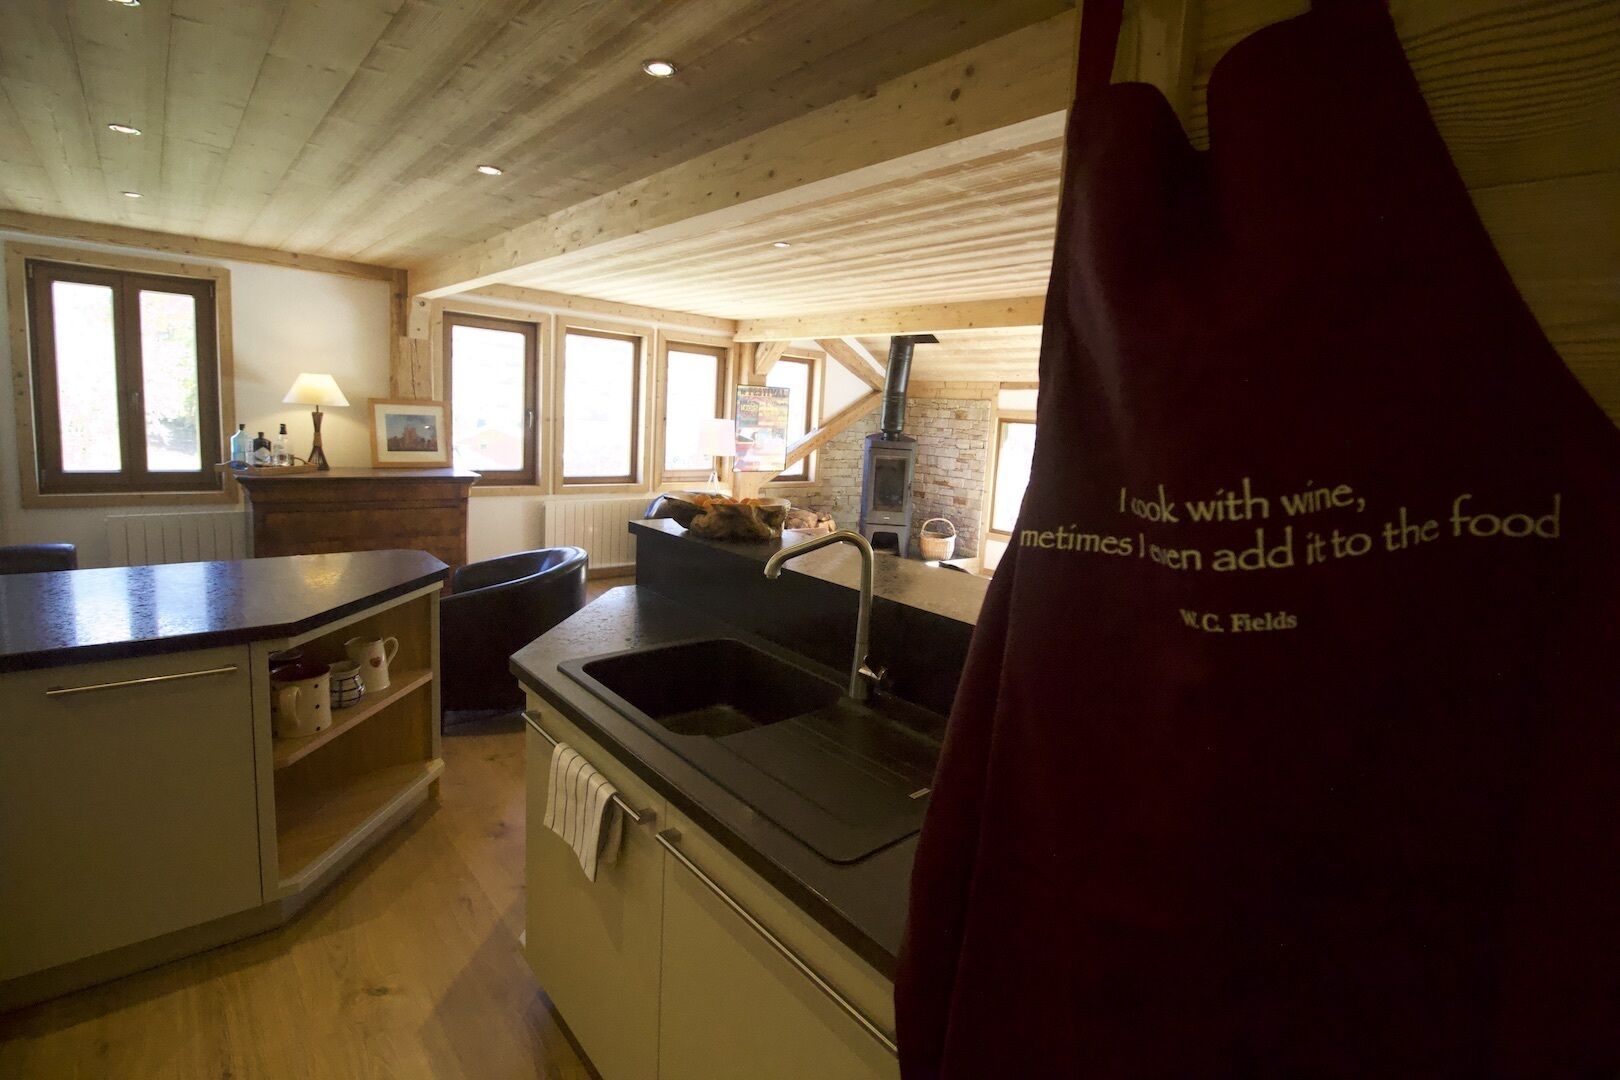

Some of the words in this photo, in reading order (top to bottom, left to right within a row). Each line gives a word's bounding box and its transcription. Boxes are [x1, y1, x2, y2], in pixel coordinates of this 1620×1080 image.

[1119, 487, 1126, 513] I
[1131, 484, 1180, 523] cook
[1185, 477, 1270, 523] with
[1280, 480, 1366, 517] wine,
[1019, 524, 1134, 557] metimes
[1139, 532, 1145, 559] I
[1149, 544, 1202, 571] even
[1212, 525, 1294, 572] add
[1306, 532, 1327, 566] it
[1331, 528, 1373, 559] to
[1383, 506, 1440, 552] the
[1449, 493, 1562, 539] food
[1230, 611, 1298, 633] Fields
